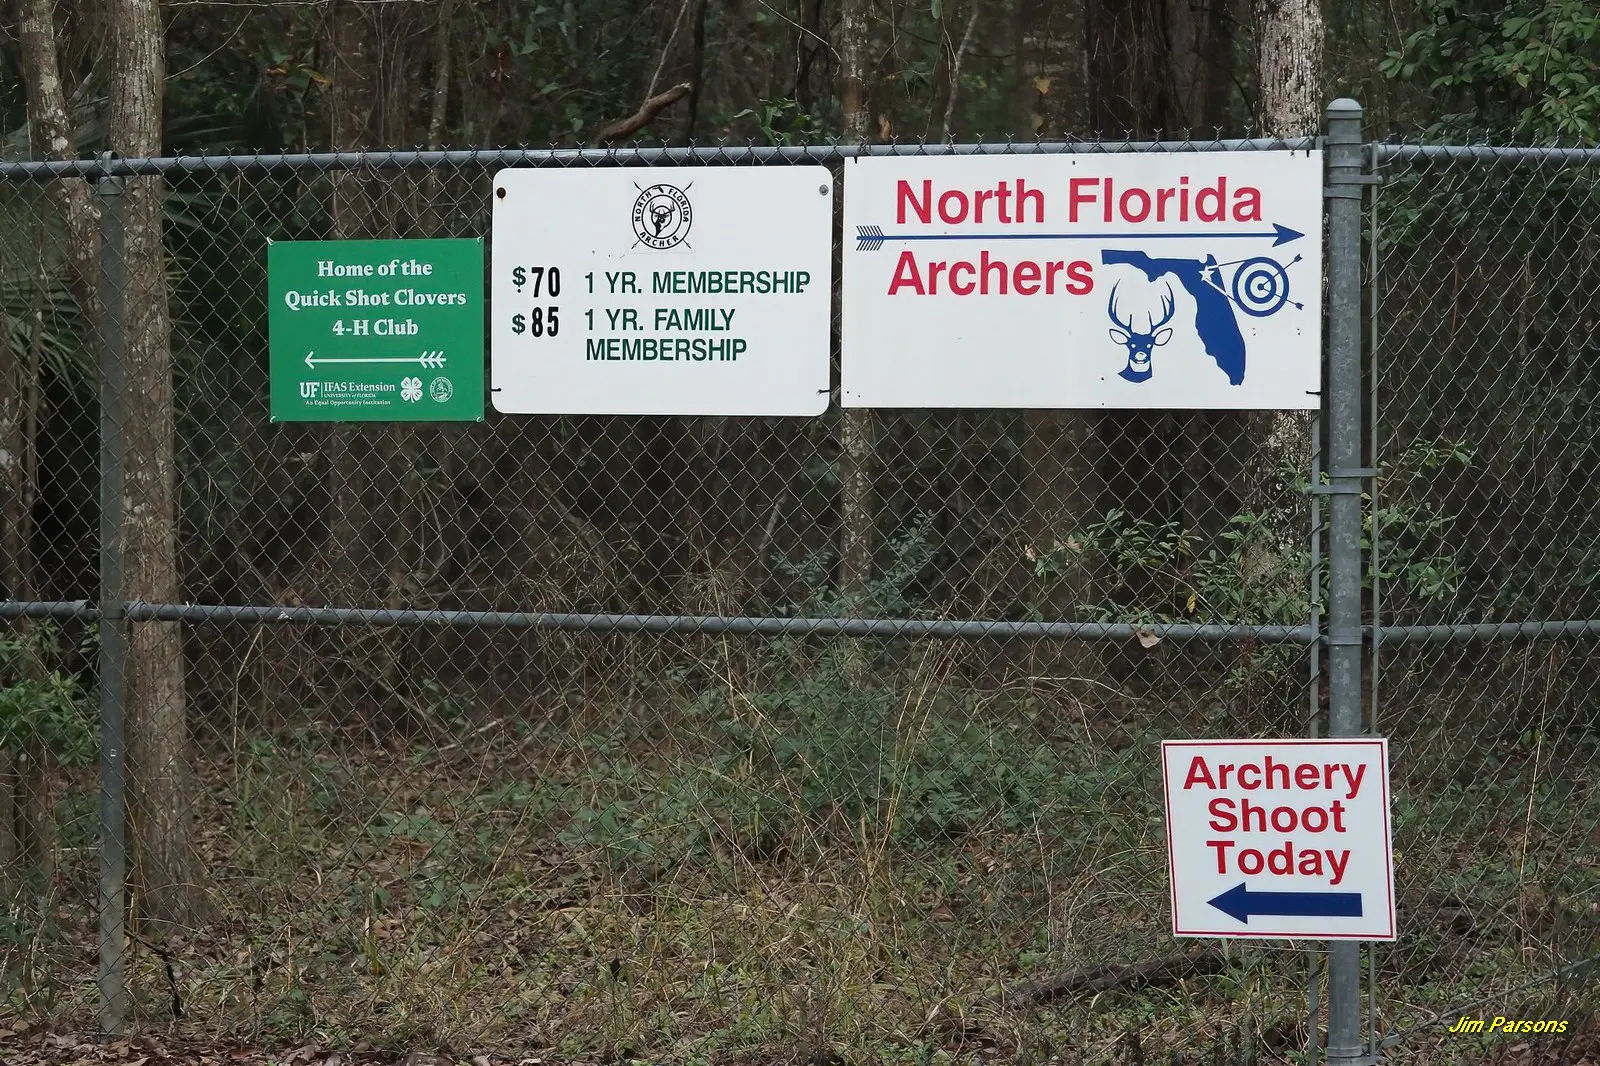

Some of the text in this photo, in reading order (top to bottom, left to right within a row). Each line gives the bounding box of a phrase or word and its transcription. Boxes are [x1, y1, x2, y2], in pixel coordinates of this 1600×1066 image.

[635, 188, 689, 222] NORTH FLORIDA
[896, 176, 1262, 225] North Florida
[640, 231, 679, 247] ARCHER
[317, 259, 433, 277] Home of the
[887, 250, 1095, 297] Archers
[585, 271, 594, 294] 1
[605, 271, 643, 294] YR.
[652, 270, 811, 294] MEMBERSHIP
[284, 289, 467, 311] Quick Shot Clovers
[332, 319, 419, 336] 4-H Club
[585, 308, 594, 331] 1
[605, 308, 645, 331] YR.
[653, 308, 736, 331] FAMILY
[586, 338, 748, 362] MEMBERSHIP
[299, 382, 320, 398] UF
[324, 381, 396, 392] IFAS Extension
[1184, 755, 1367, 799] Archery
[1208, 797, 1347, 833] Shoot
[1207, 840, 1350, 885] Today
